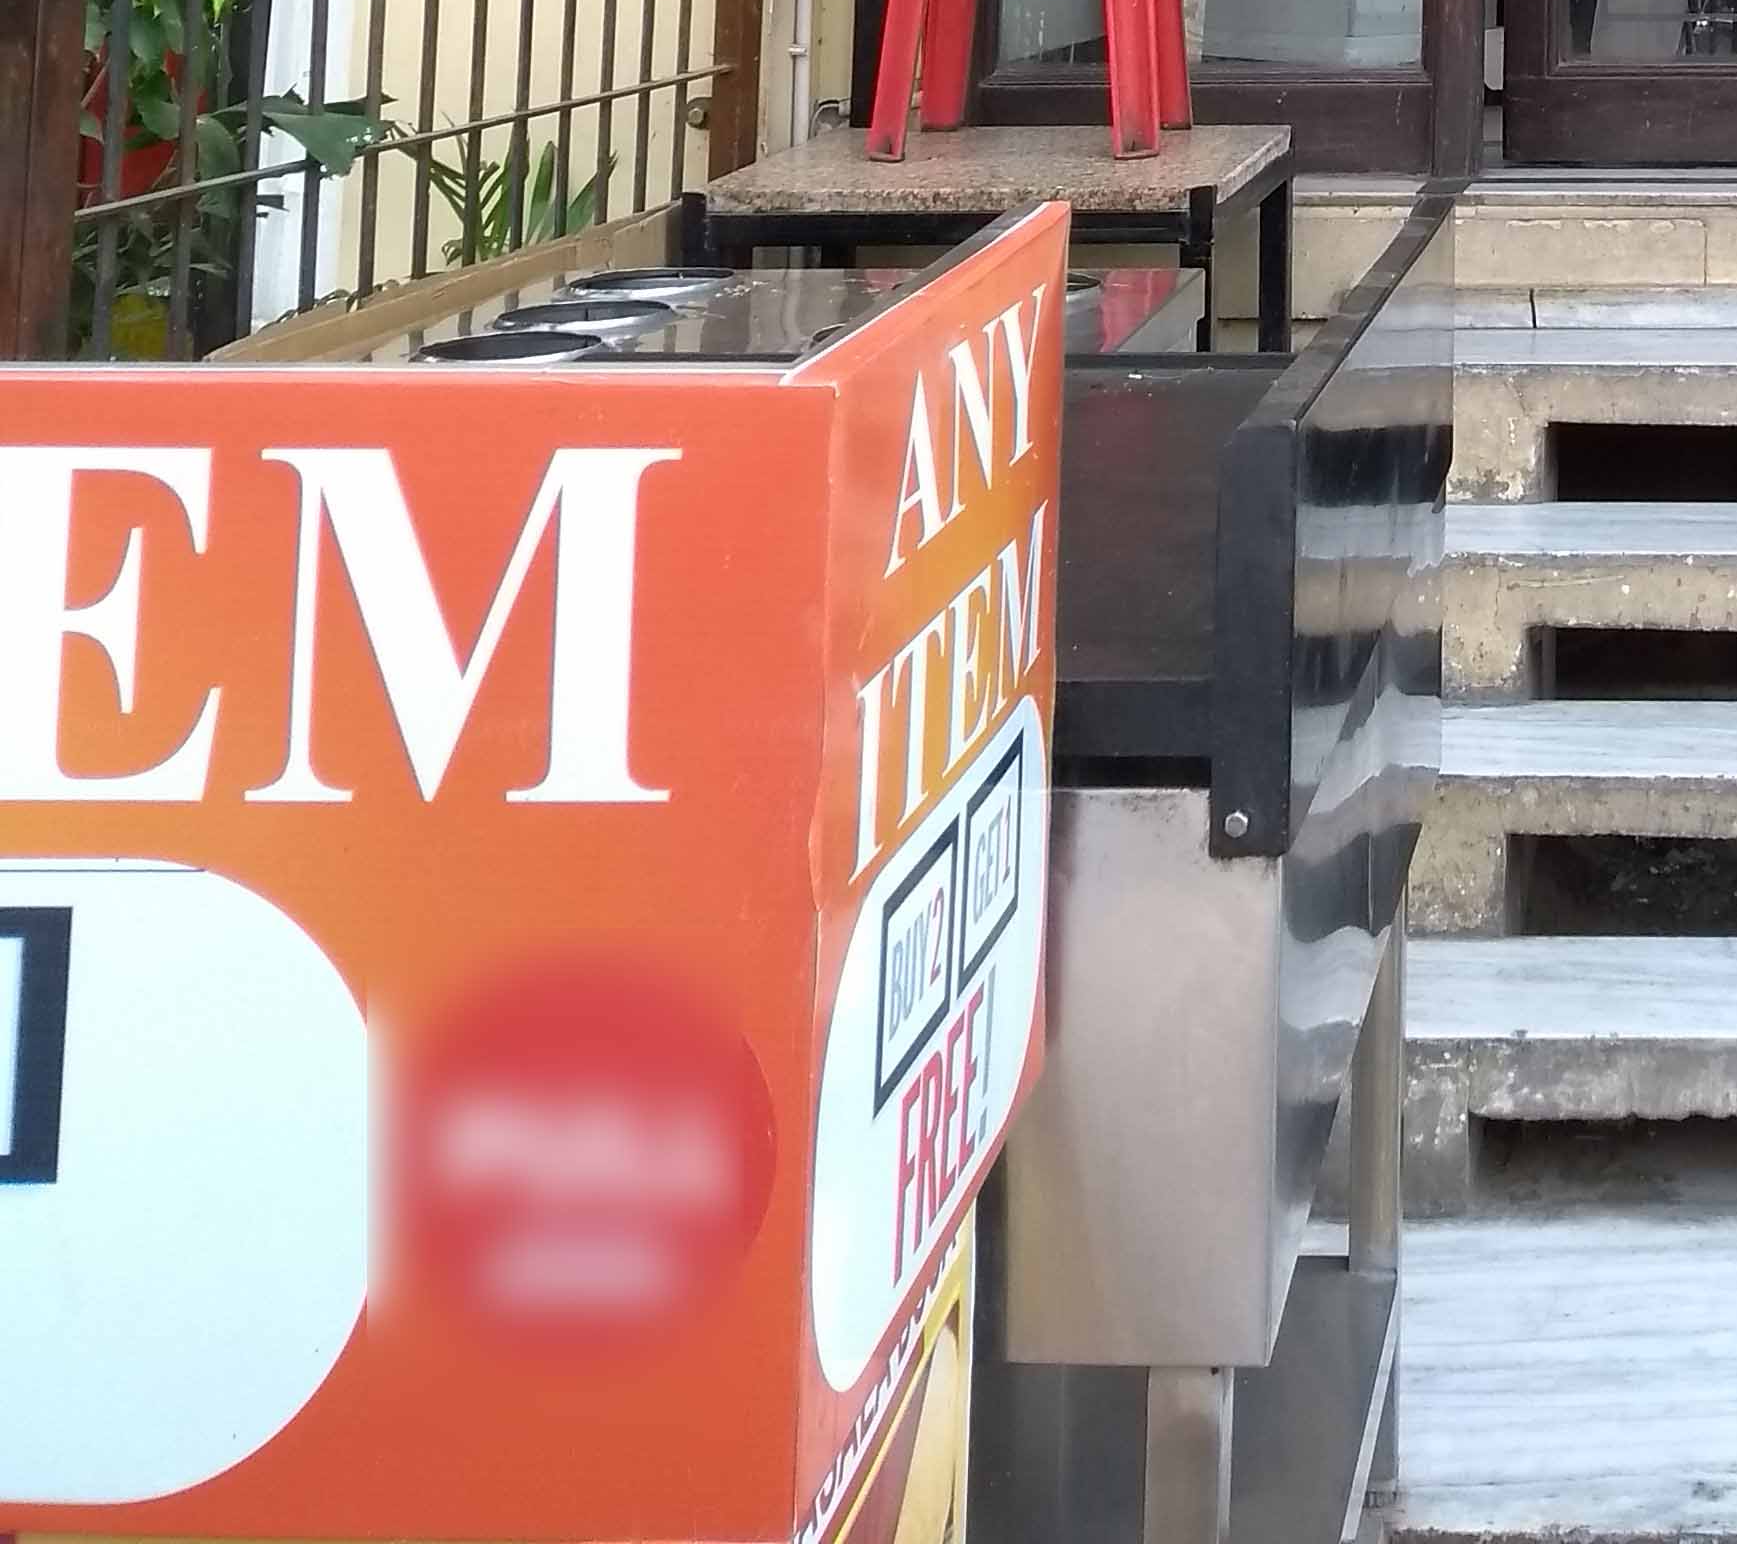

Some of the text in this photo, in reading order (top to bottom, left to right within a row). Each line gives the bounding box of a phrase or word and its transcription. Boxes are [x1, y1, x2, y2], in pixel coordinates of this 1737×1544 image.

[884, 283, 1047, 580] ANY
[848, 499, 1048, 884] ITEM
[892, 963, 997, 1289] FREE!
